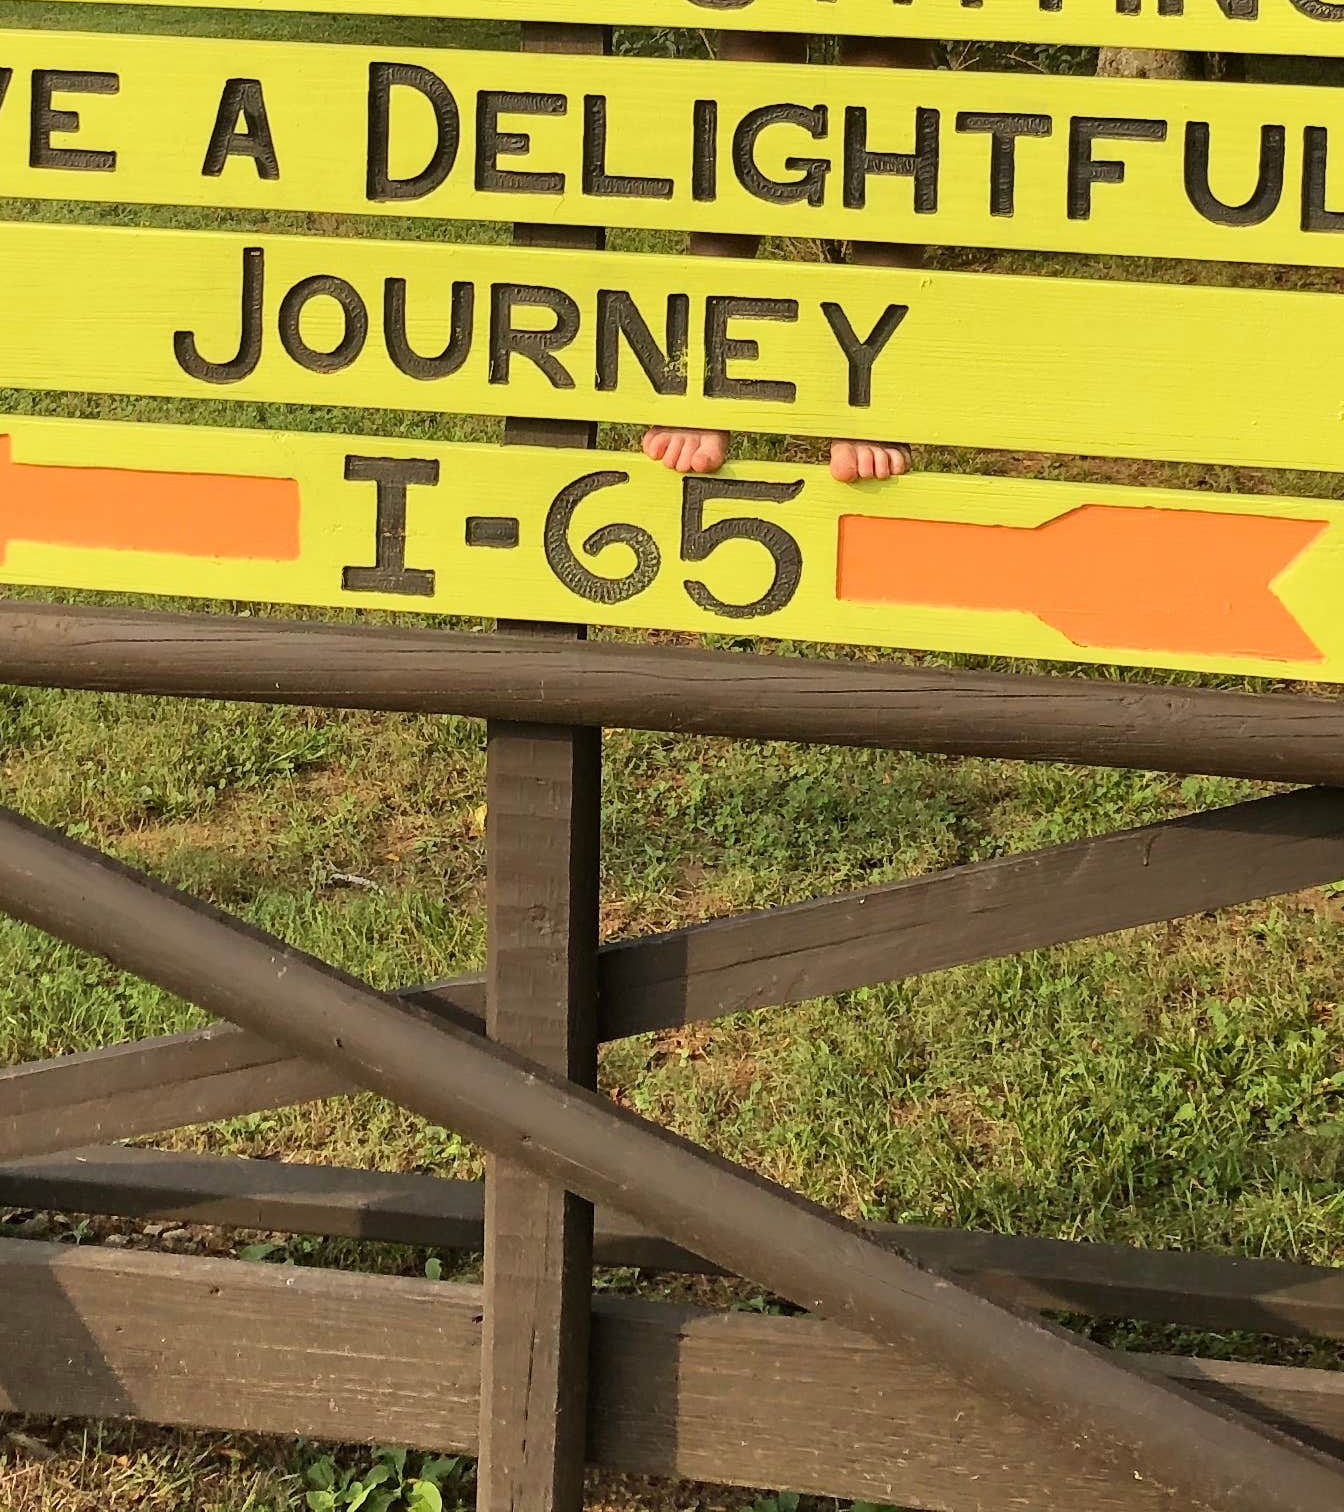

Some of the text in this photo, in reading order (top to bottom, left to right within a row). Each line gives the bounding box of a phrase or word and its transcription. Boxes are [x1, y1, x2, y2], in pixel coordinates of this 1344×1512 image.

[202, 77, 279, 180] A
[173, 247, 909, 408] JOURNEY
[341, 453, 805, 619] I-65
